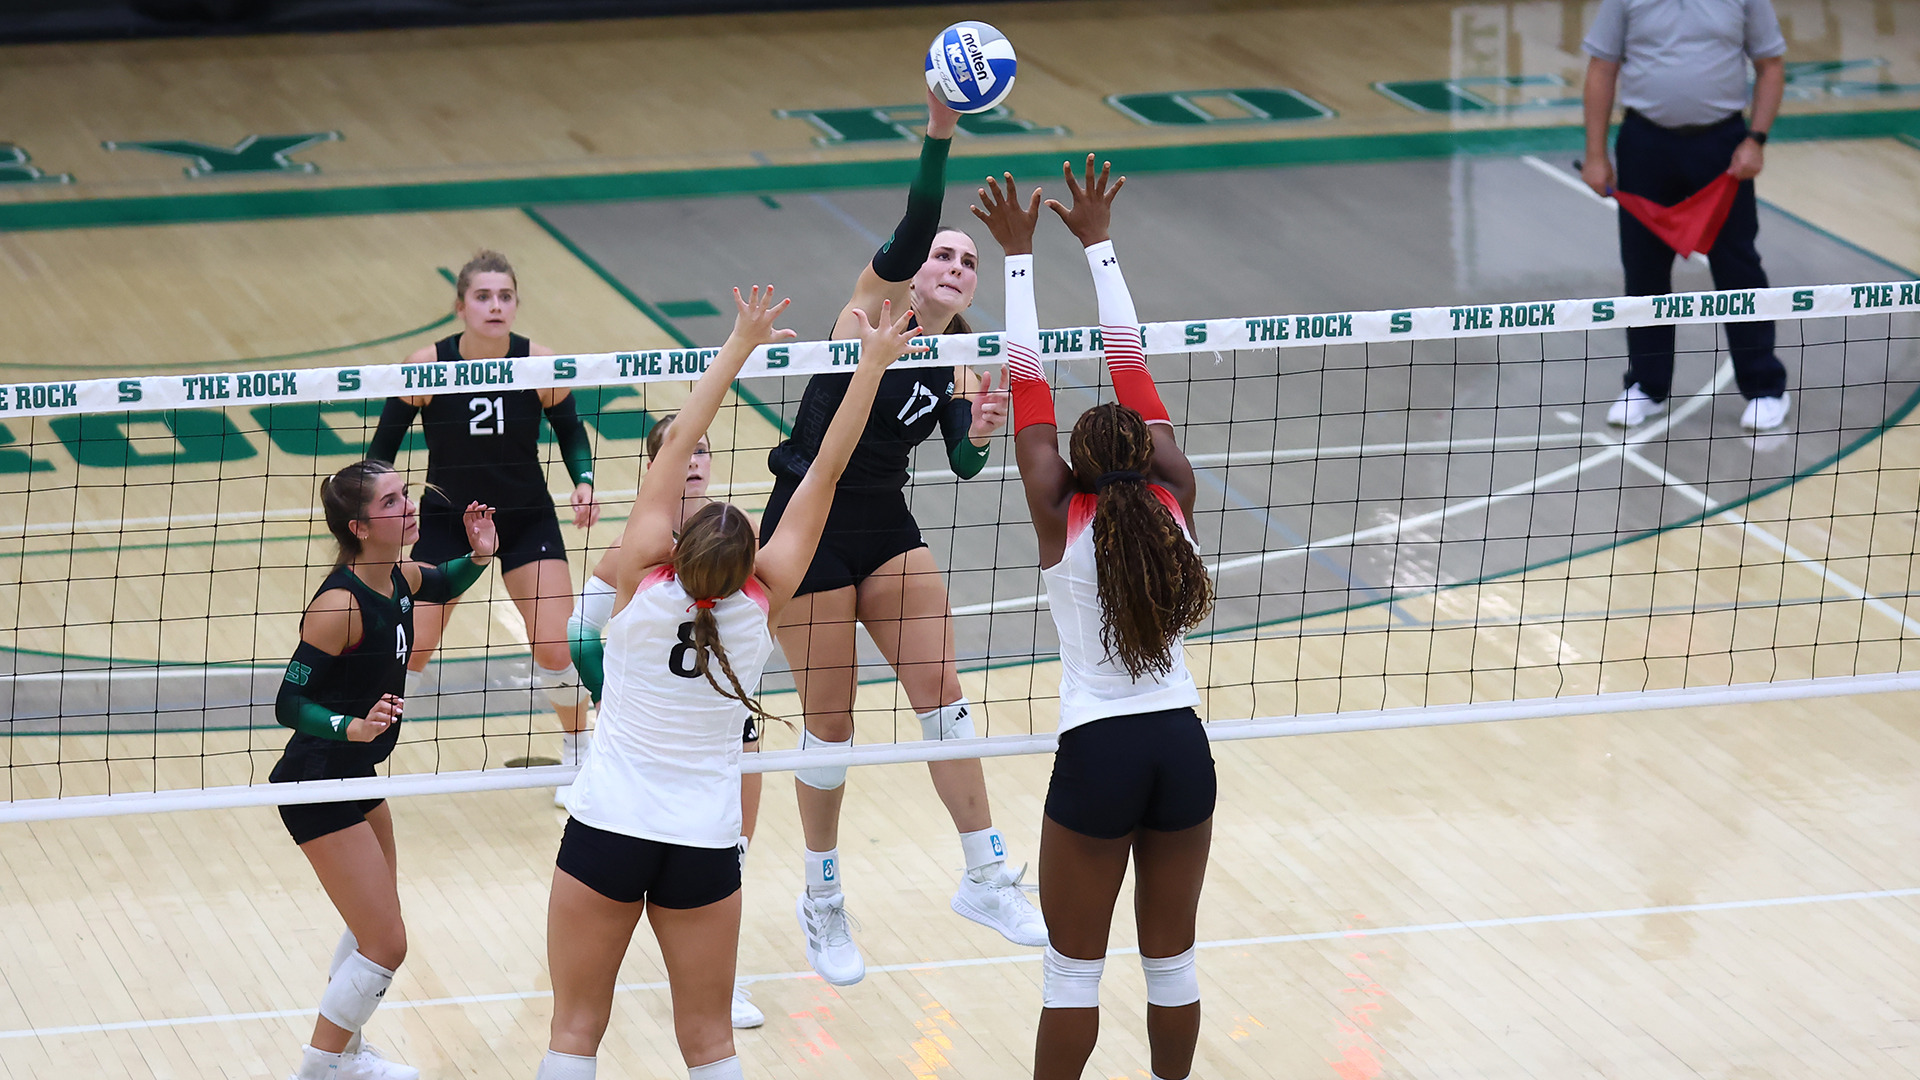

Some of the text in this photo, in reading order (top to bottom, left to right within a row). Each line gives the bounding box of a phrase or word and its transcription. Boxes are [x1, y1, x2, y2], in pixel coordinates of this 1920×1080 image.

[945, 42, 972, 83] NCAA
[962, 33, 988, 80] molten
[1652, 292, 1755, 319] THE ROCK
[1792, 290, 1814, 312] S
[1851, 286, 1893, 308] THE
[1390, 312, 1412, 333] S
[1450, 303, 1555, 331] THE ROCK
[1592, 300, 1615, 323] S
[1039, 329, 1083, 353] THE
[1185, 323, 1207, 345] S
[1246, 314, 1353, 342] THE ROCK
[767, 347, 790, 369] S
[829, 342, 860, 365] TH
[978, 335, 1001, 357] S
[402, 361, 514, 388] THE ROCK
[553, 358, 577, 380] S
[616, 350, 719, 377] THE ROC
[118, 380, 142, 403] S
[183, 372, 297, 400] THE ROCK
[337, 370, 361, 392] S
[15, 383, 78, 410] ROCK
[897, 381, 940, 426] 17
[468, 396, 505, 436] 21
[396, 623, 408, 665] 4
[668, 621, 710, 678] 8
[285, 660, 312, 686] S
